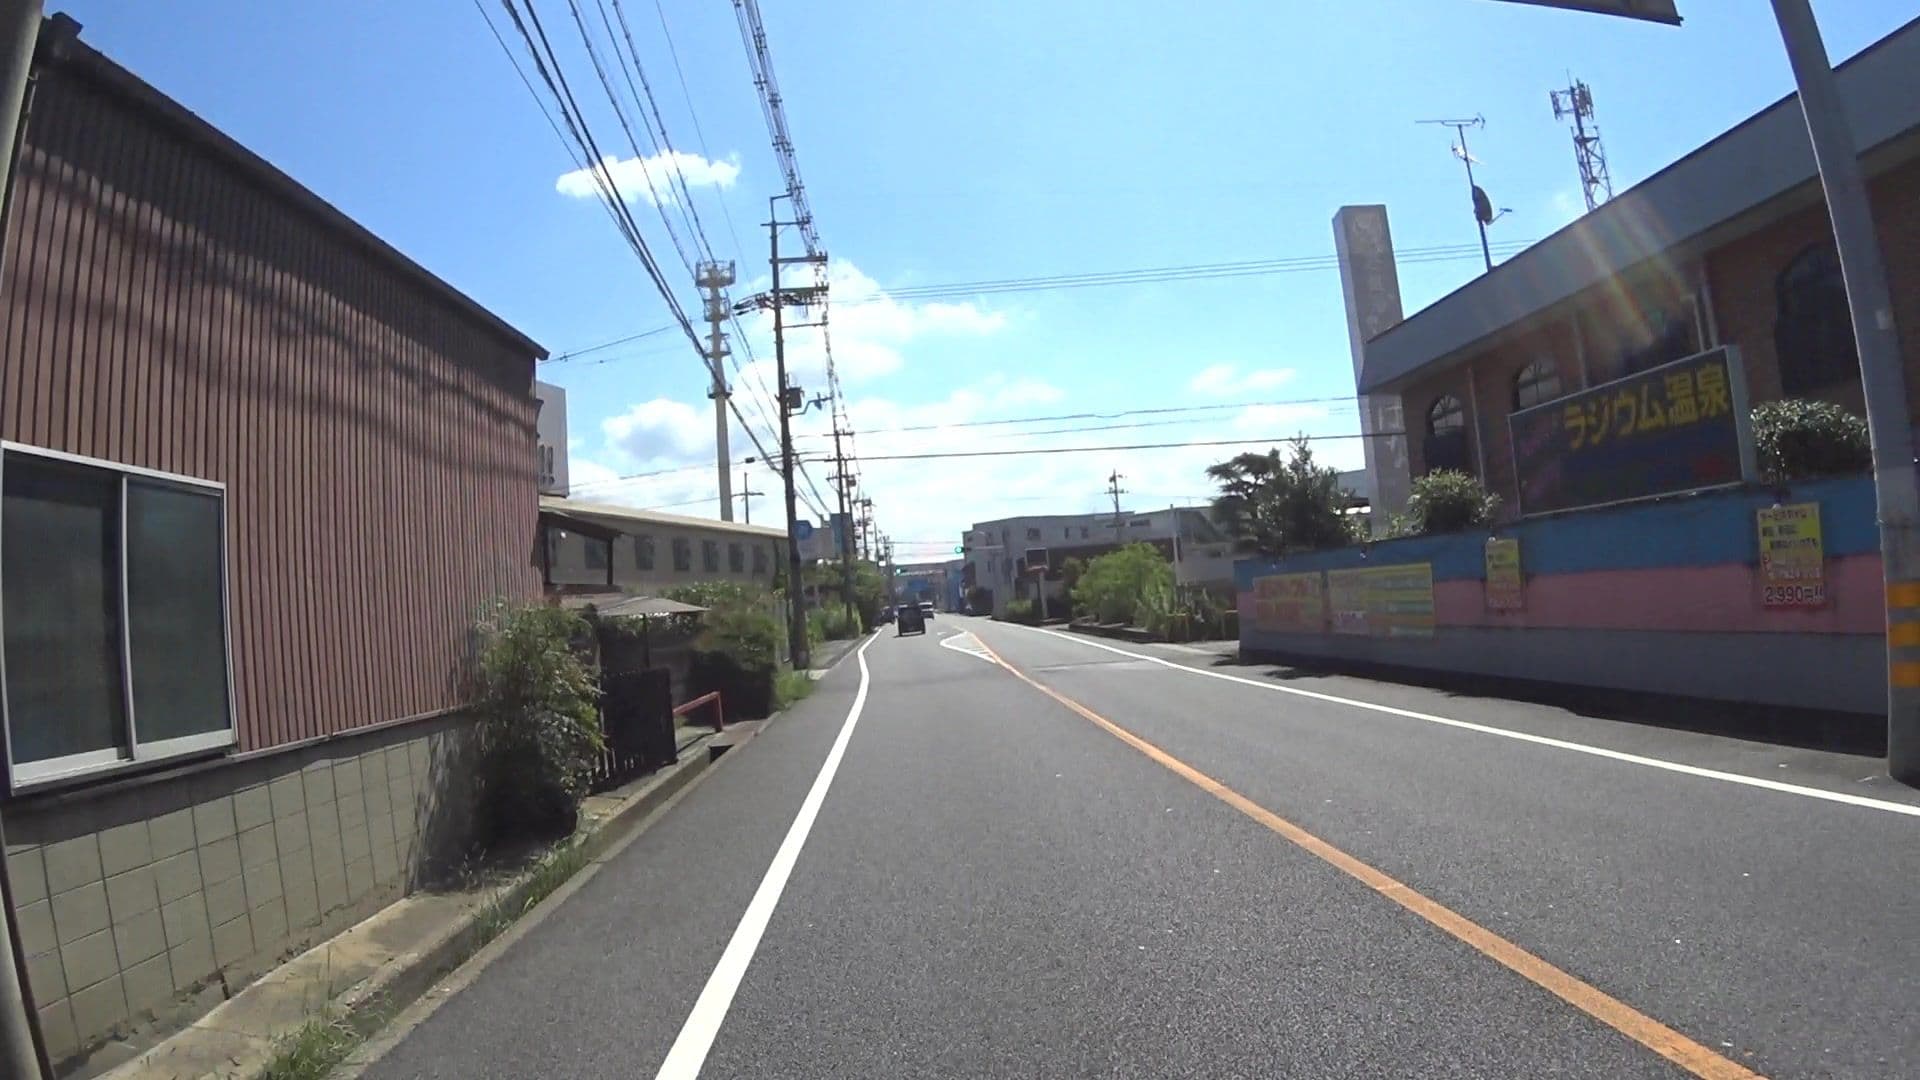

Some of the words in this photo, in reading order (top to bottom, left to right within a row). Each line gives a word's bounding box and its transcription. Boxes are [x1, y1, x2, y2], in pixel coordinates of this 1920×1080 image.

[1565, 364, 1728, 448] ラジウム温泉
